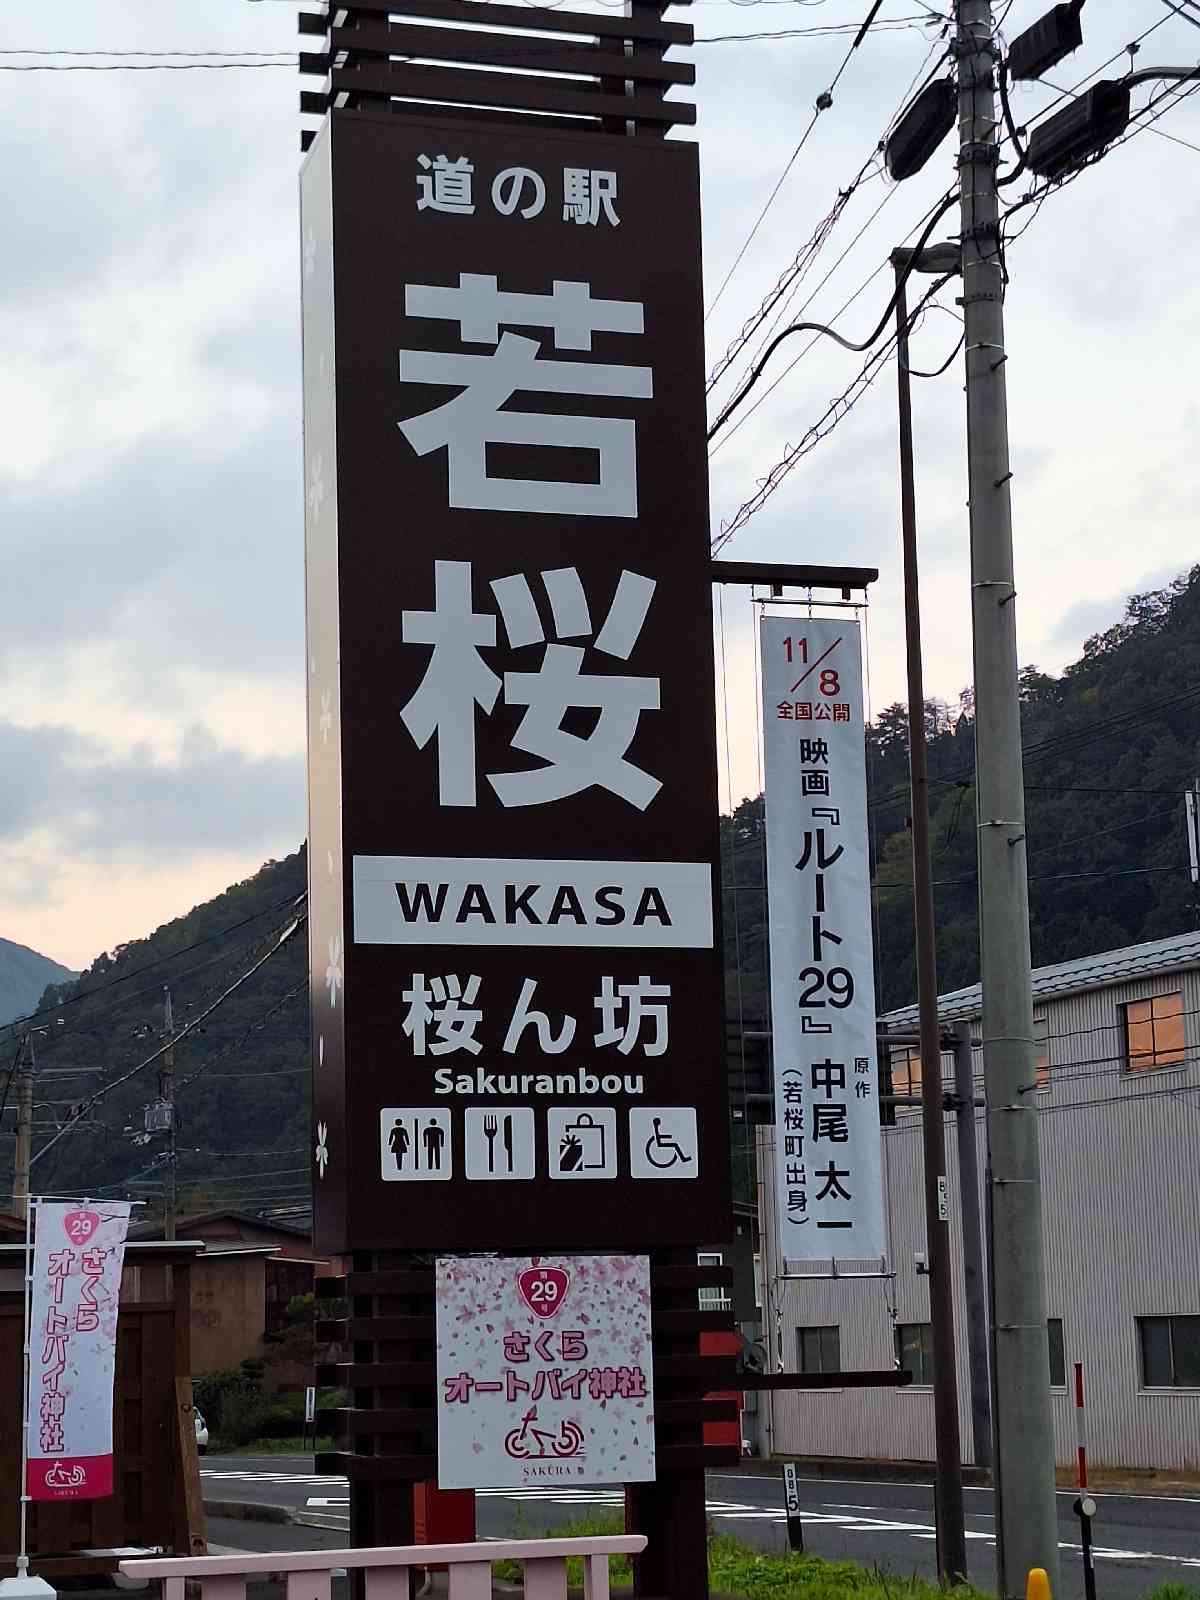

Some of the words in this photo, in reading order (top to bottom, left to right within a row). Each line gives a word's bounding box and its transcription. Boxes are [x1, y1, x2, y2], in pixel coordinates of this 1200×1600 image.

[416, 154, 620, 227] 道の駅
[398, 273, 664, 811] 若桜
[776, 701, 850, 722] 全国公開
[395, 882, 672, 927] WAKASA
[402, 973, 672, 1057] 桜ん坊
[434, 1067, 644, 1094] Sakuranbou
[854, 1057, 871, 1099] 原作
[71, 1219, 92, 1236] 29
[76, 1247, 107, 1332] さくら
[530, 1281, 558, 1302] 29
[39, 1248, 75, 1453] オートバイ神社
[503, 1331, 588, 1364] さくら
[444, 1367, 648, 1404] オートバイ神社
